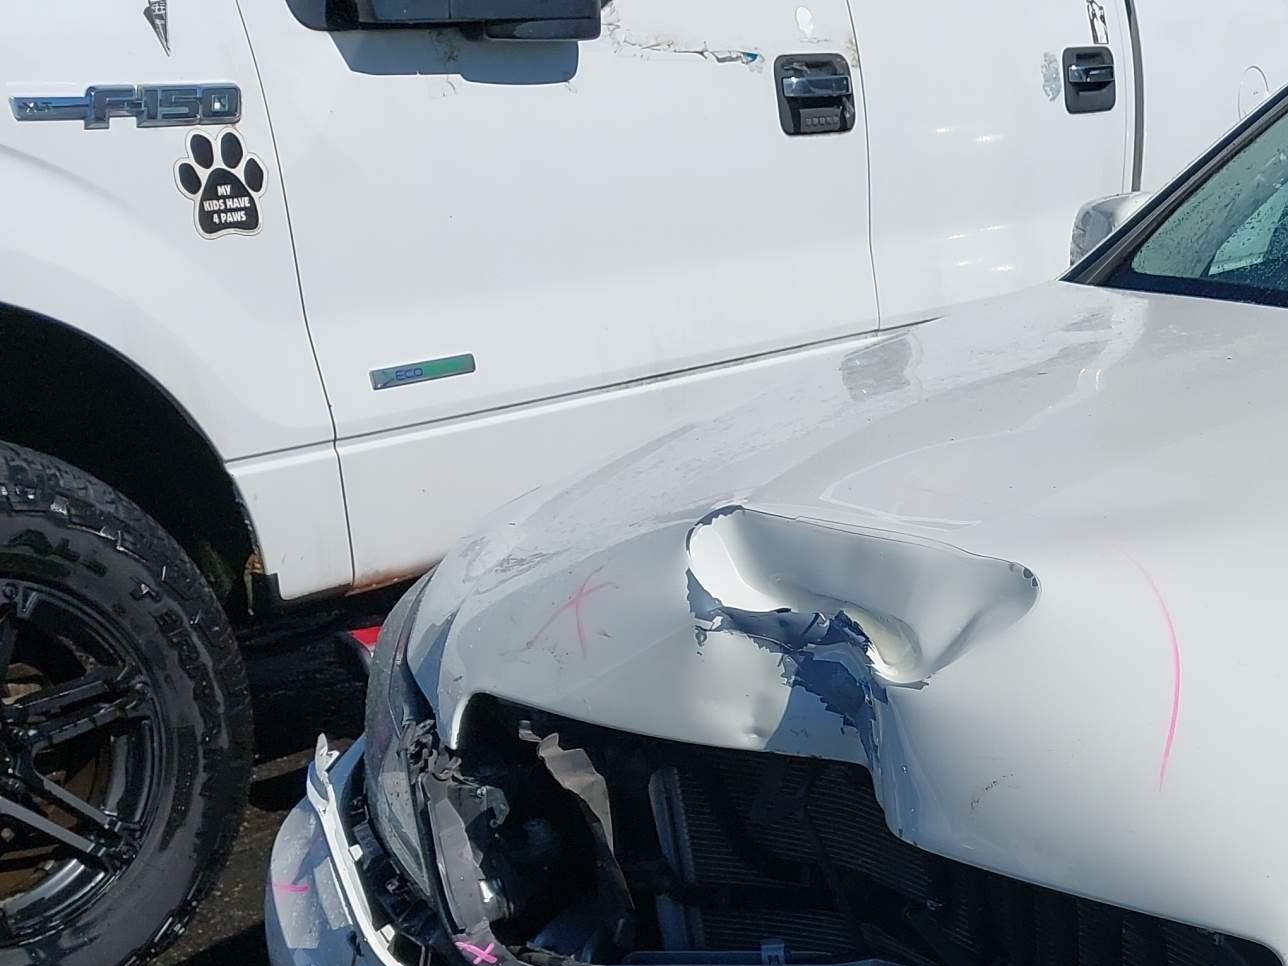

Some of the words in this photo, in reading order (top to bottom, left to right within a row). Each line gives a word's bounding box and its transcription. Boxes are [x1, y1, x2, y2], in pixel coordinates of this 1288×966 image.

[84, 83, 242, 129] F-150
[216, 184, 231, 196] MY
[203, 199, 225, 212] KIDS
[226, 197, 250, 210] HAVE
[213, 212, 219, 224] 4
[221, 211, 247, 223] PAWS
[395, 368, 424, 381] ECO
